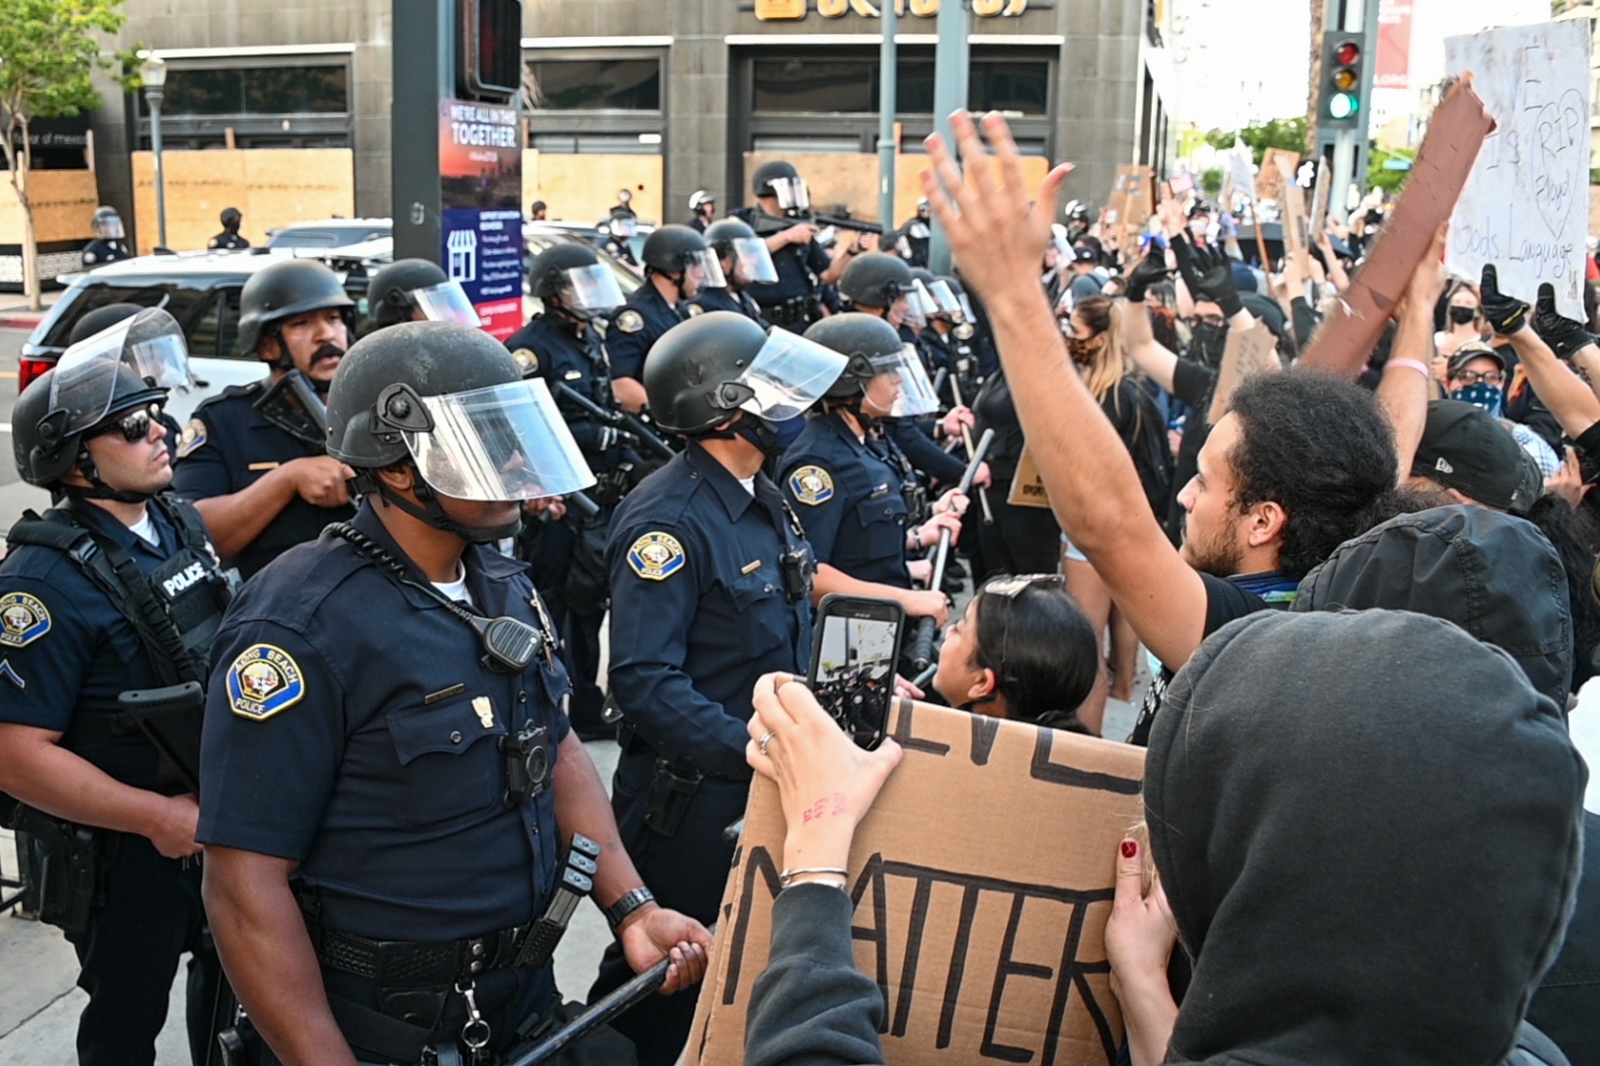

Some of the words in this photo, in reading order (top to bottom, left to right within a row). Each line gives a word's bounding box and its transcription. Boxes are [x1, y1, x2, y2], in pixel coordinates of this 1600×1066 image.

[1509, 202, 1573, 279] Language
[163, 561, 206, 597] POLICE
[22, 596, 48, 622] BEACH
[235, 648, 261, 672] LONG
[266, 649, 299, 684] BEACH
[235, 697, 266, 715] POLICE
